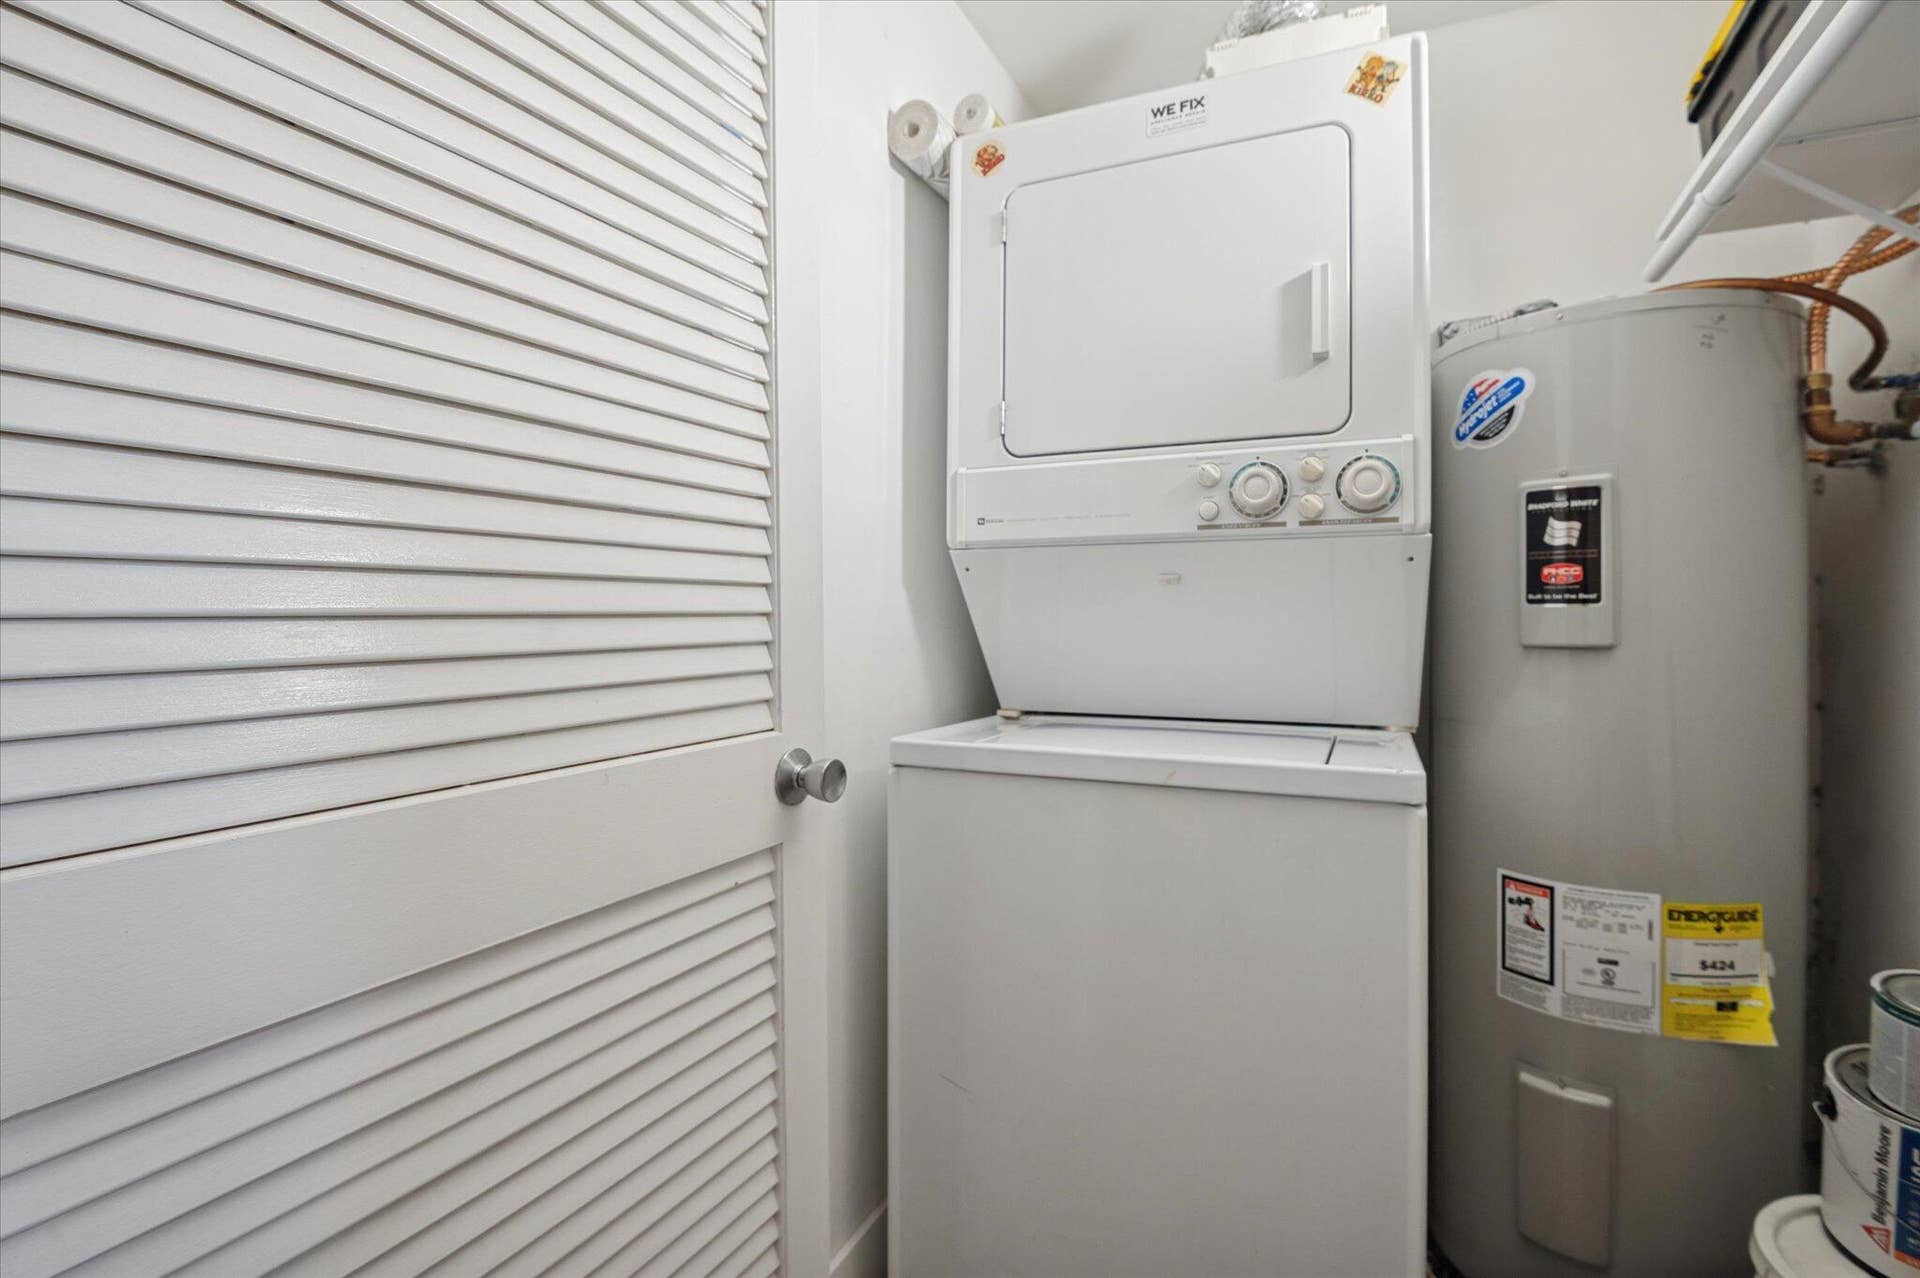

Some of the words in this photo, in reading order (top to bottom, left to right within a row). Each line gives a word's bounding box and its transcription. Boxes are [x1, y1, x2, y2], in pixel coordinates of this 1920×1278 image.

[1151, 102, 1176, 119] WE
[1179, 95, 1205, 113] FIX
[1699, 959, 1736, 971] $424
[1873, 1124, 1892, 1167] Moore
[1871, 1167, 1889, 1225] Benjamin
